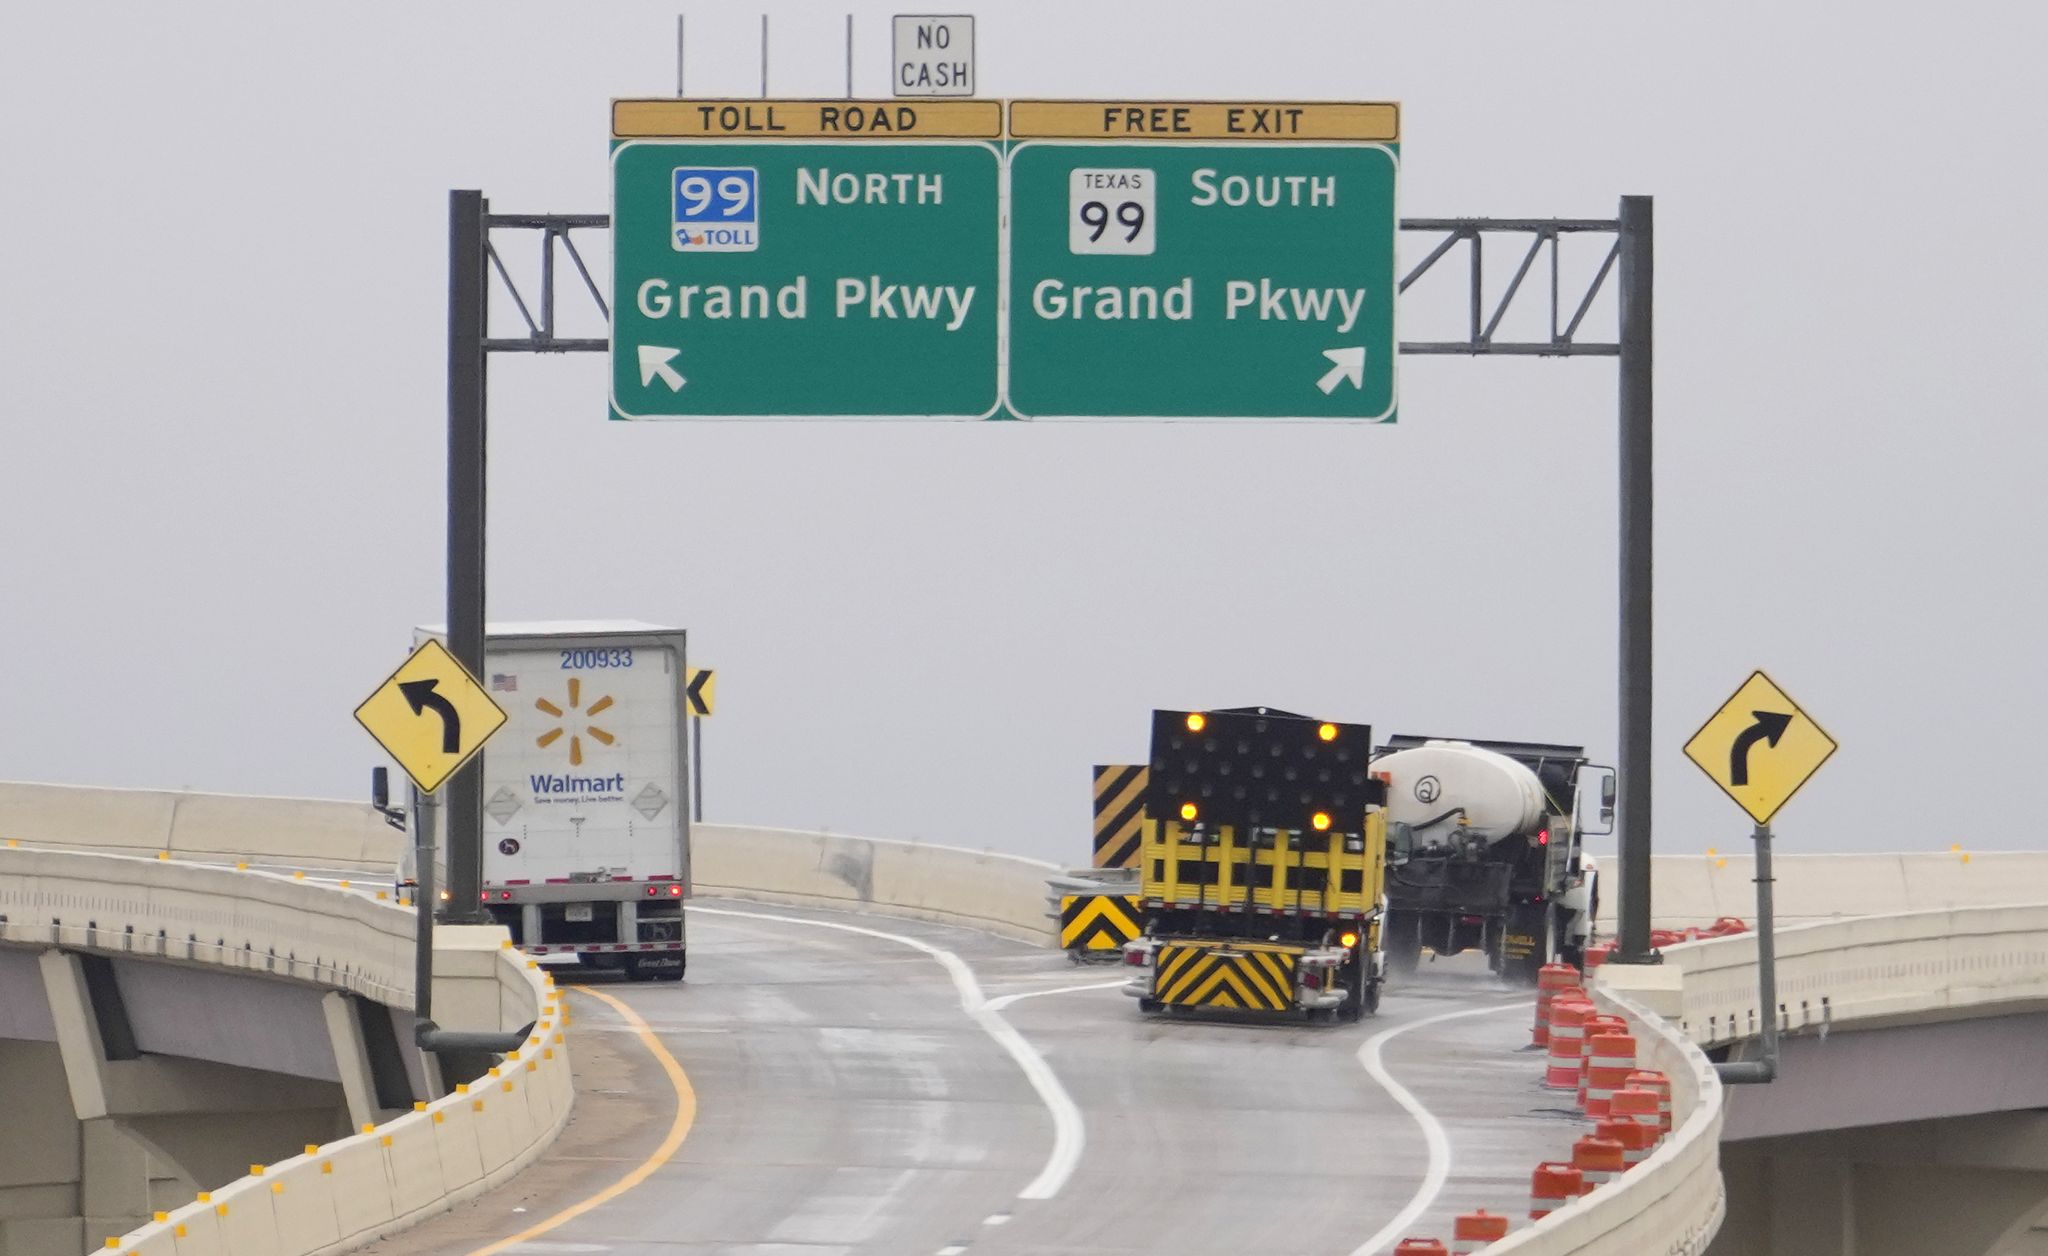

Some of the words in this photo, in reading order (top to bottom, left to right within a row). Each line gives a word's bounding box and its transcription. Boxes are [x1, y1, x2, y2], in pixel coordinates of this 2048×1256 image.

[917, 25, 950, 50] NO
[901, 62, 967, 88] CASH
[697, 106, 786, 131] TOLL
[820, 107, 918, 132] ROAD
[1103, 108, 1191, 133] FREE
[1227, 109, 1304, 134] EXIT
[796, 167, 944, 206] NORTH
[1084, 174, 1142, 190] TEXAS
[1190, 168, 1336, 208] SOUTH
[679, 176, 750, 217] 99
[1079, 201, 1145, 244] 99
[704, 229, 755, 247] TOLL
[637, 275, 807, 320] Grand
[835, 276, 976, 331] Pkwy
[1032, 277, 1193, 321] Grand
[1225, 278, 1366, 333] Pkwy
[560, 649, 633, 670] 200933
[530, 773, 625, 794] Walmart
